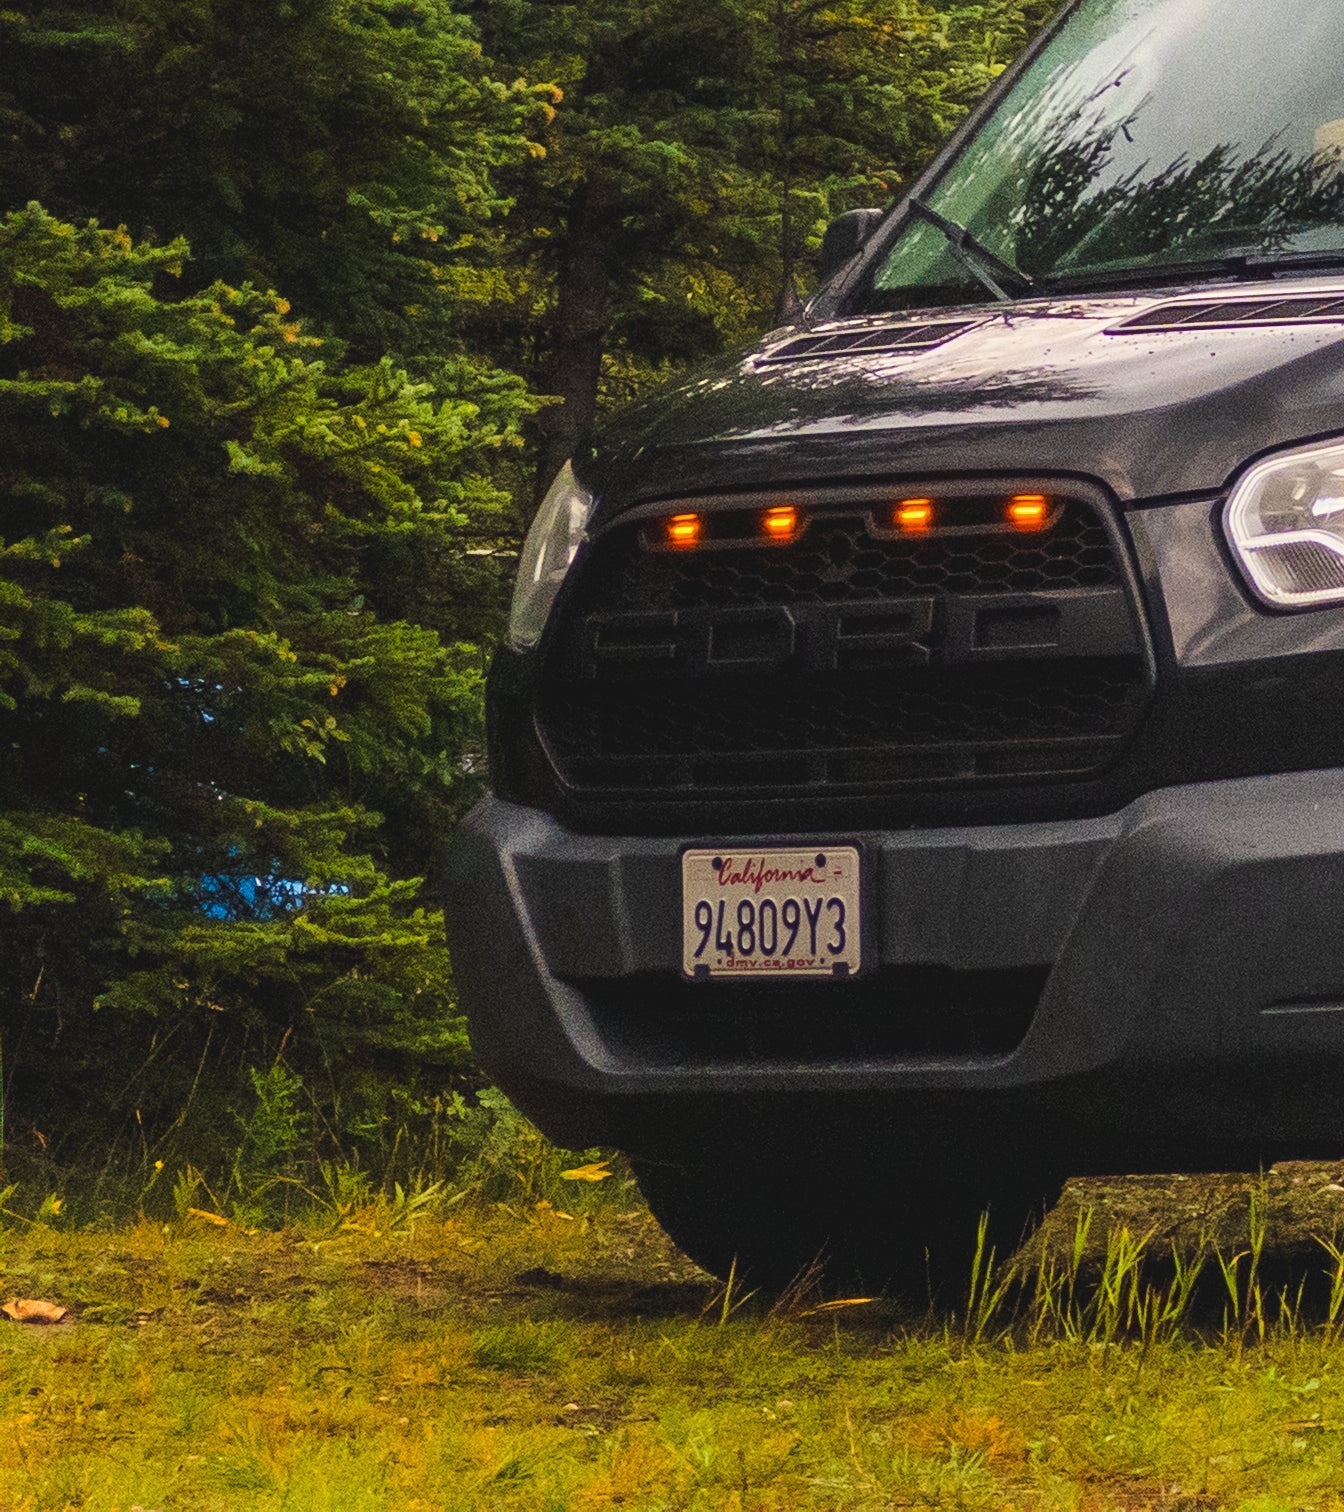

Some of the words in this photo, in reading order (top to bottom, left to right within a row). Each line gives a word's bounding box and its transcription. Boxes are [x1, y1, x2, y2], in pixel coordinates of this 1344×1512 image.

[717, 857, 826, 894] California
[693, 896, 847, 958] 94809Y3
[726, 954, 815, 969] dmv.ca.gov
